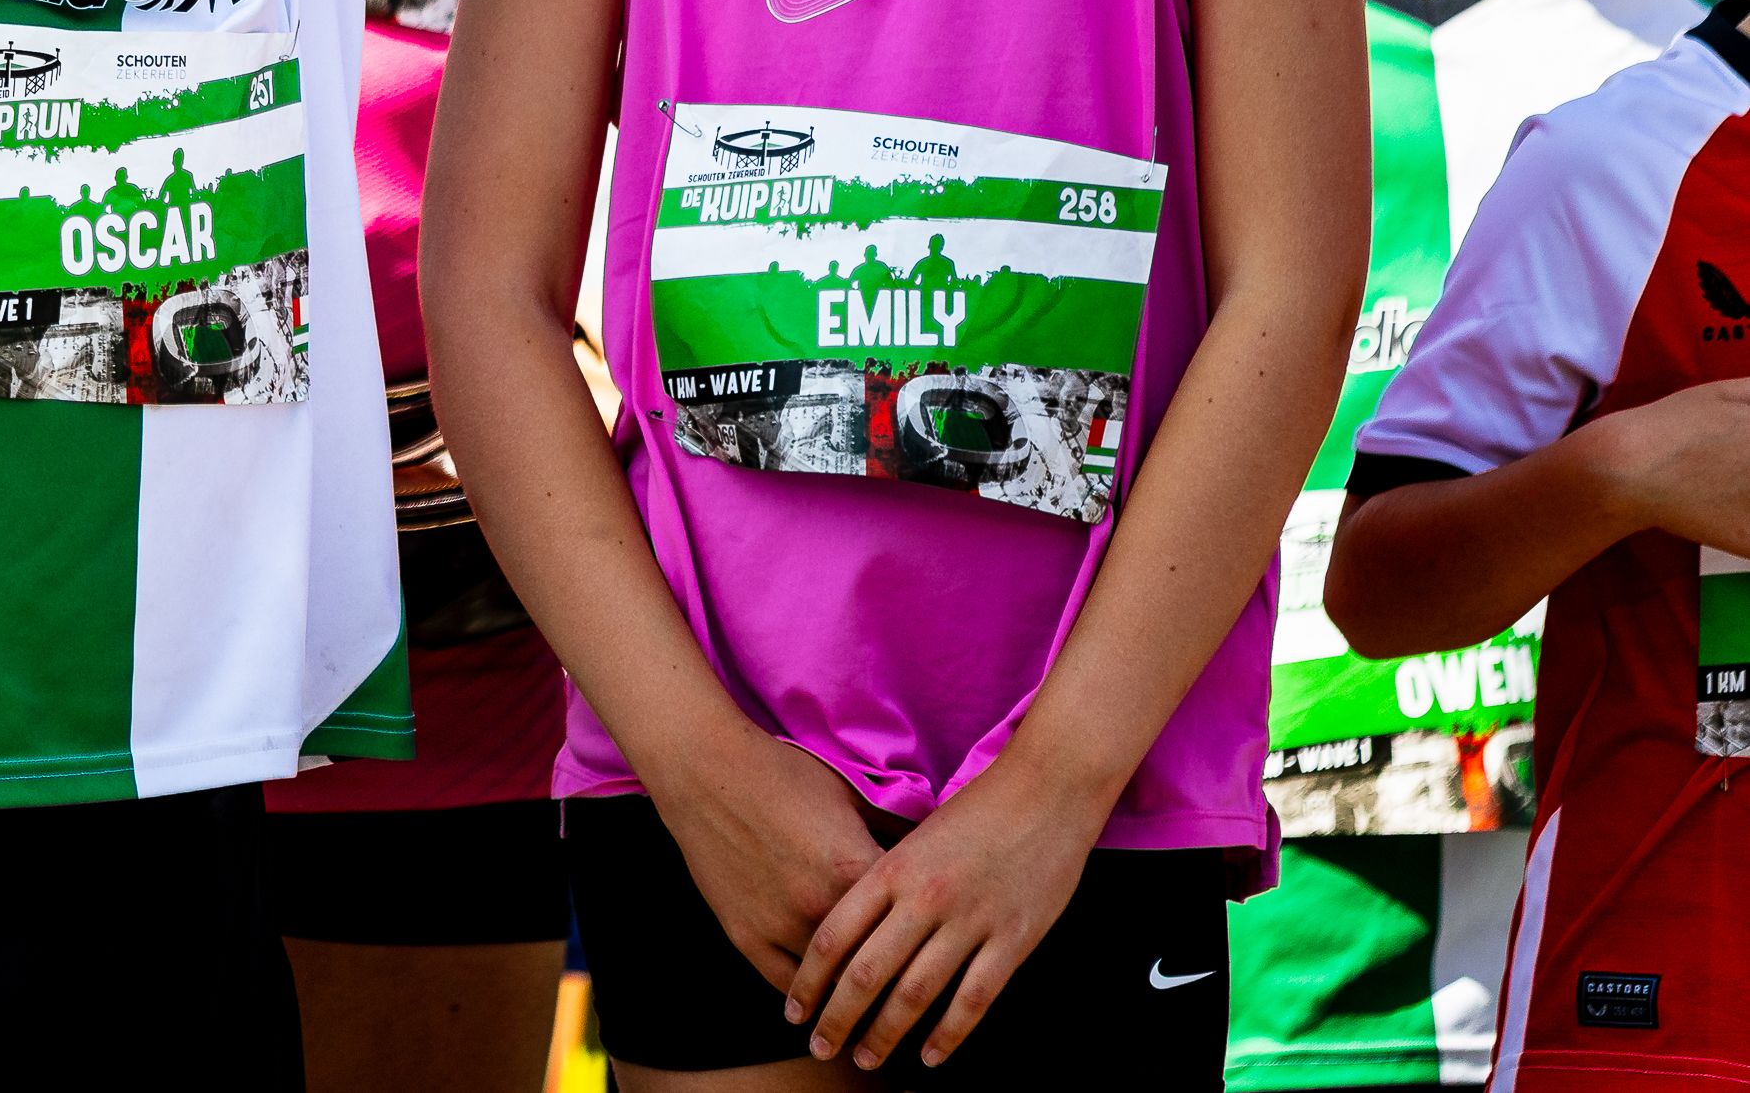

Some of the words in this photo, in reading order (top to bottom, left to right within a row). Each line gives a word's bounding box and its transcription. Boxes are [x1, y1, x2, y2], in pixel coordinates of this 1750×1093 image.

[116, 54, 187, 67] SCHOUTEN
[116, 69, 187, 80] ZEKERHEID
[249, 70, 275, 111] 257
[870, 148, 958, 170] ZEKERHEID
[872, 136, 960, 158] SCHOUTEN
[688, 172, 726, 183] SCHOUTEN
[681, 188, 704, 209] DE
[1058, 187, 1118, 224] 258
[60, 202, 216, 276] OSCAR
[25, 297, 33, 321] 1
[817, 288, 967, 347] EMILY
[668, 378, 675, 399] 1
[676, 376, 697, 399] KM
[710, 369, 763, 396] WAVE
[769, 368, 776, 391] 1
[1394, 644, 1535, 719] OWEN
[1706, 671, 1714, 695] 1
[1717, 669, 1747, 694] KM
[1587, 982, 1650, 995] CASTORE
